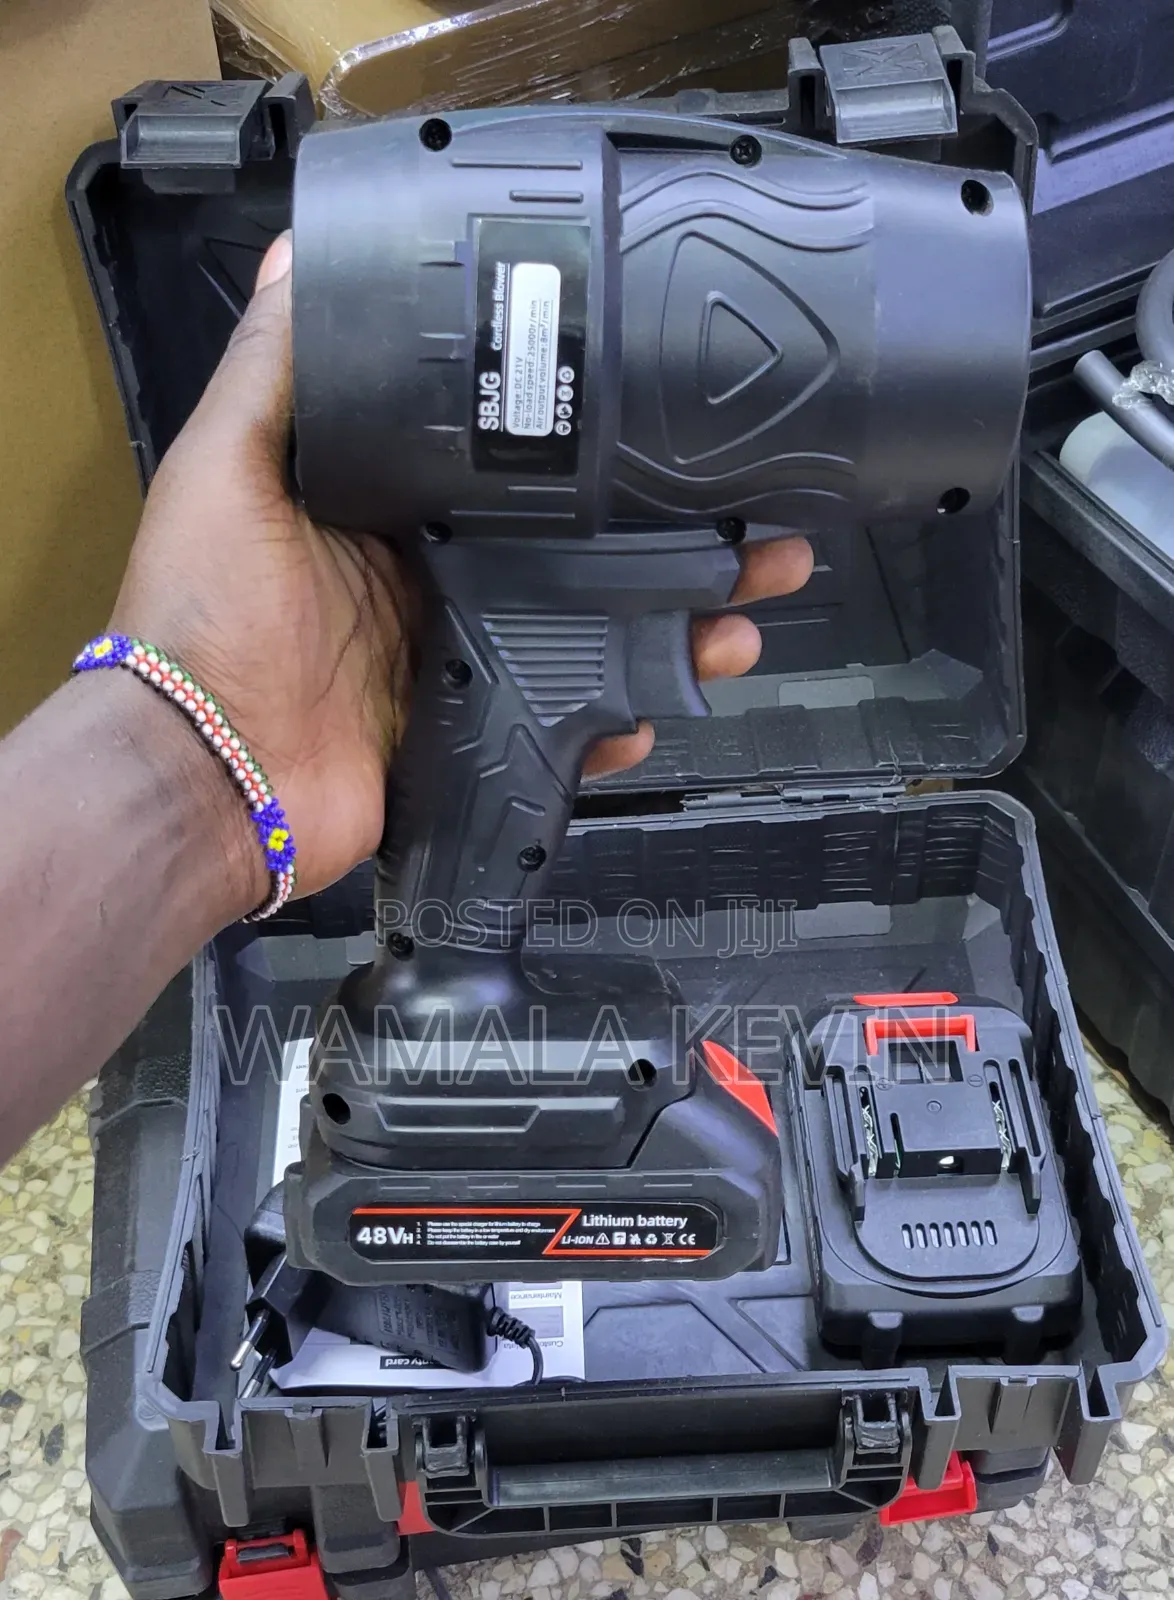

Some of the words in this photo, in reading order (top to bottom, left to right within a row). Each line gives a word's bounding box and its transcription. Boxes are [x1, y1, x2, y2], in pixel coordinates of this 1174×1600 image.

[494, 262, 506, 302] Blower
[490, 303, 504, 350] Cordless
[478, 372, 501, 430] SBJG
[523, 392, 533, 430] No-load
[537, 384, 546, 415] output
[582, 1214, 634, 1227] Lithium
[637, 1214, 688, 1229] battery
[510, 1292, 562, 1300] Maintenance
[385, 1358, 410, 1367] card
